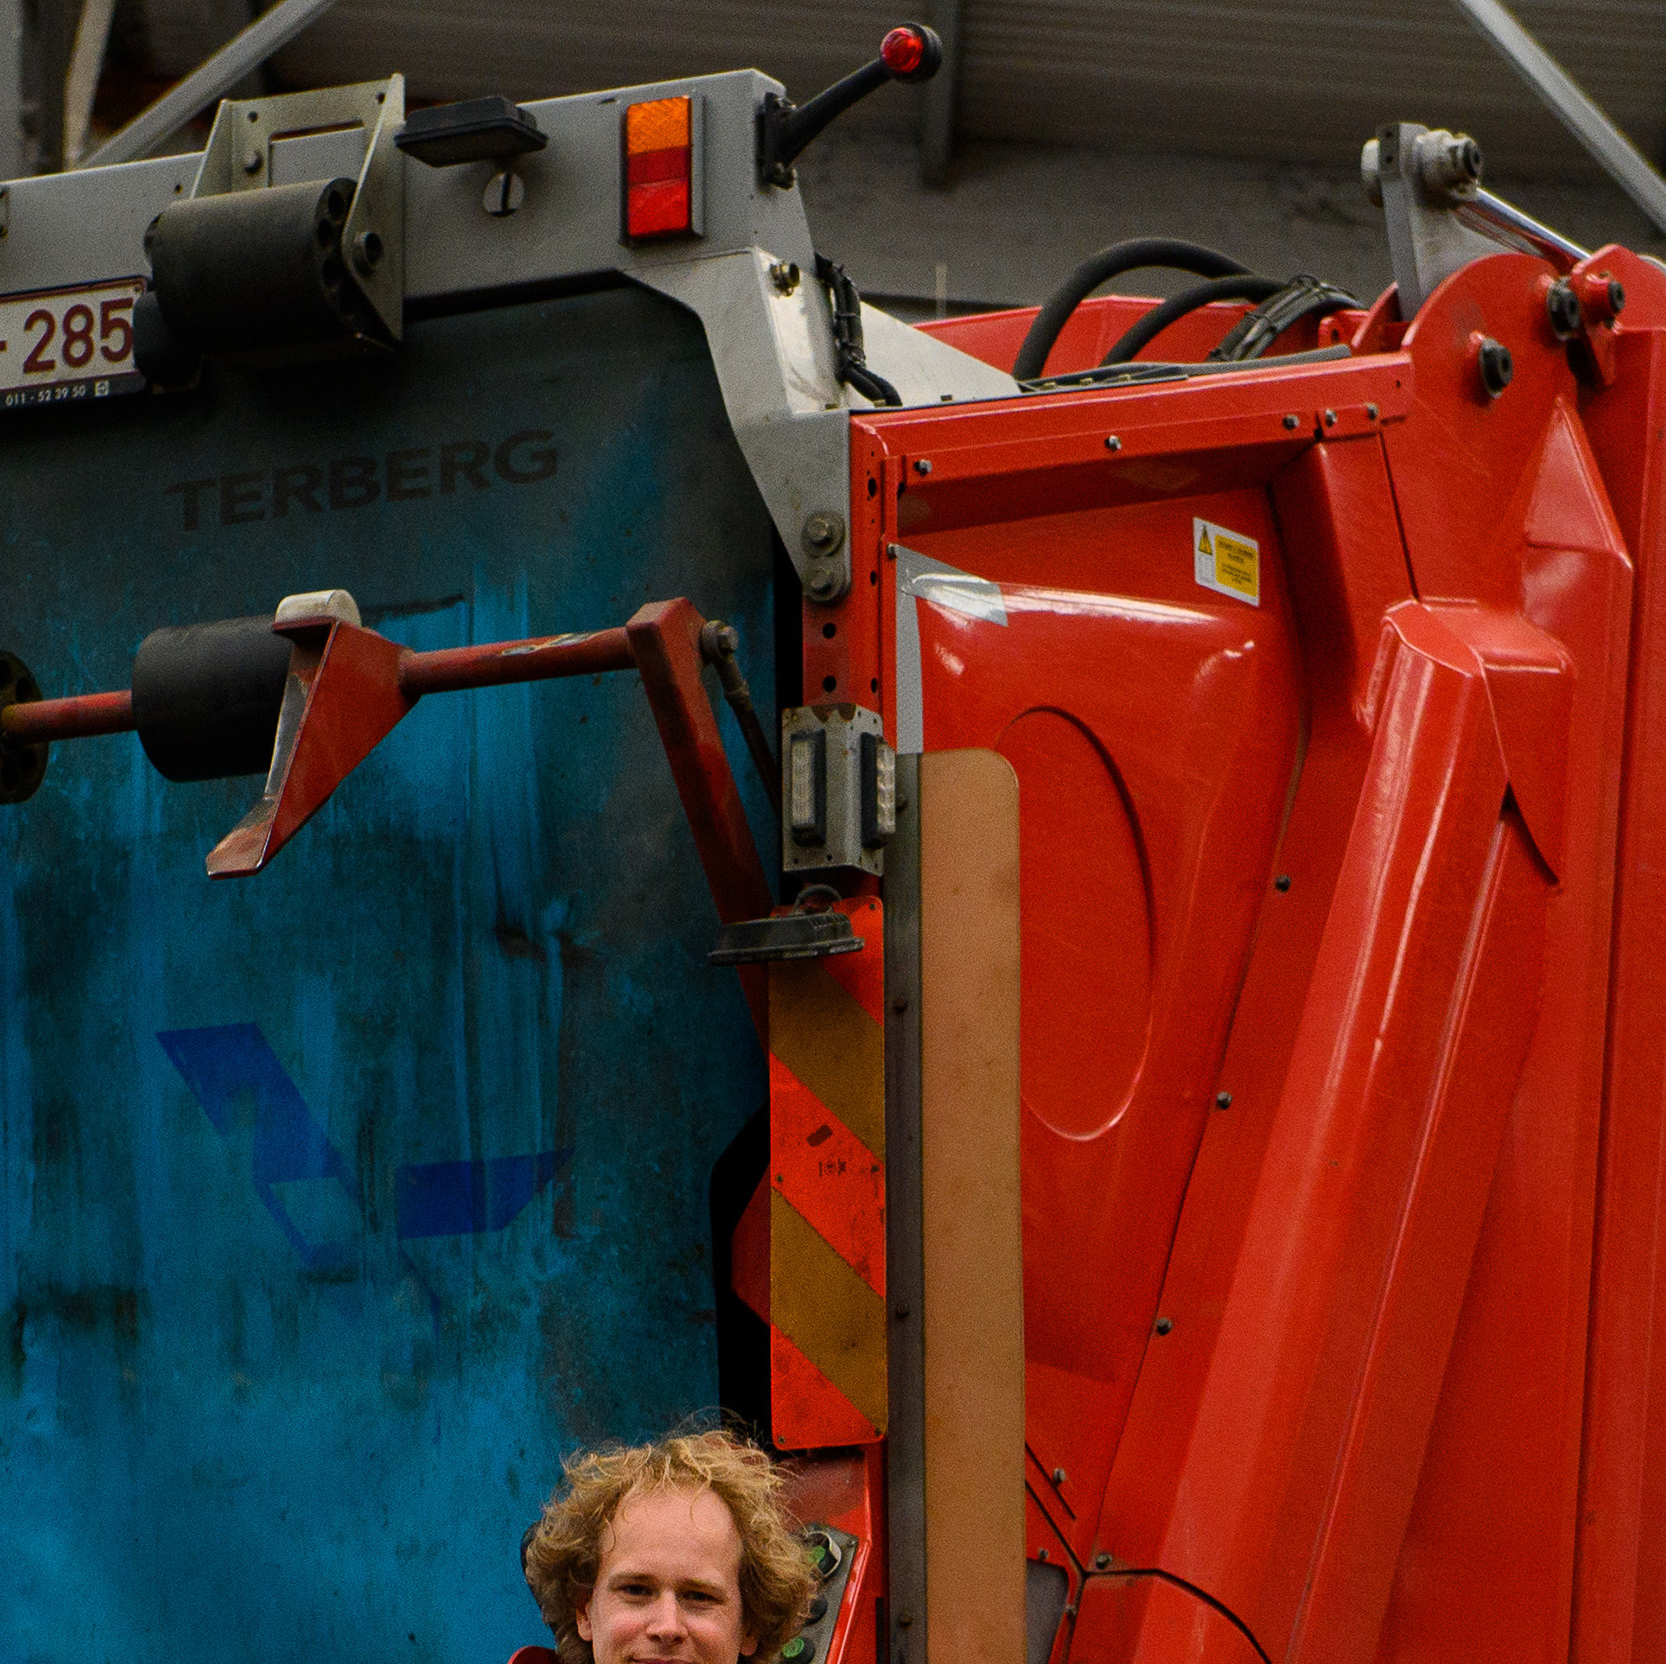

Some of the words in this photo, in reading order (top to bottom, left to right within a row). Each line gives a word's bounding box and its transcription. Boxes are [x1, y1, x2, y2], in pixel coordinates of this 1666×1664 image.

[5, 390, 27, 406] 011
[38, 387, 52, 403] 52
[55, 386, 69, 400] 39
[72, 384, 86, 398] 50
[165, 428, 559, 533] TERBERG
